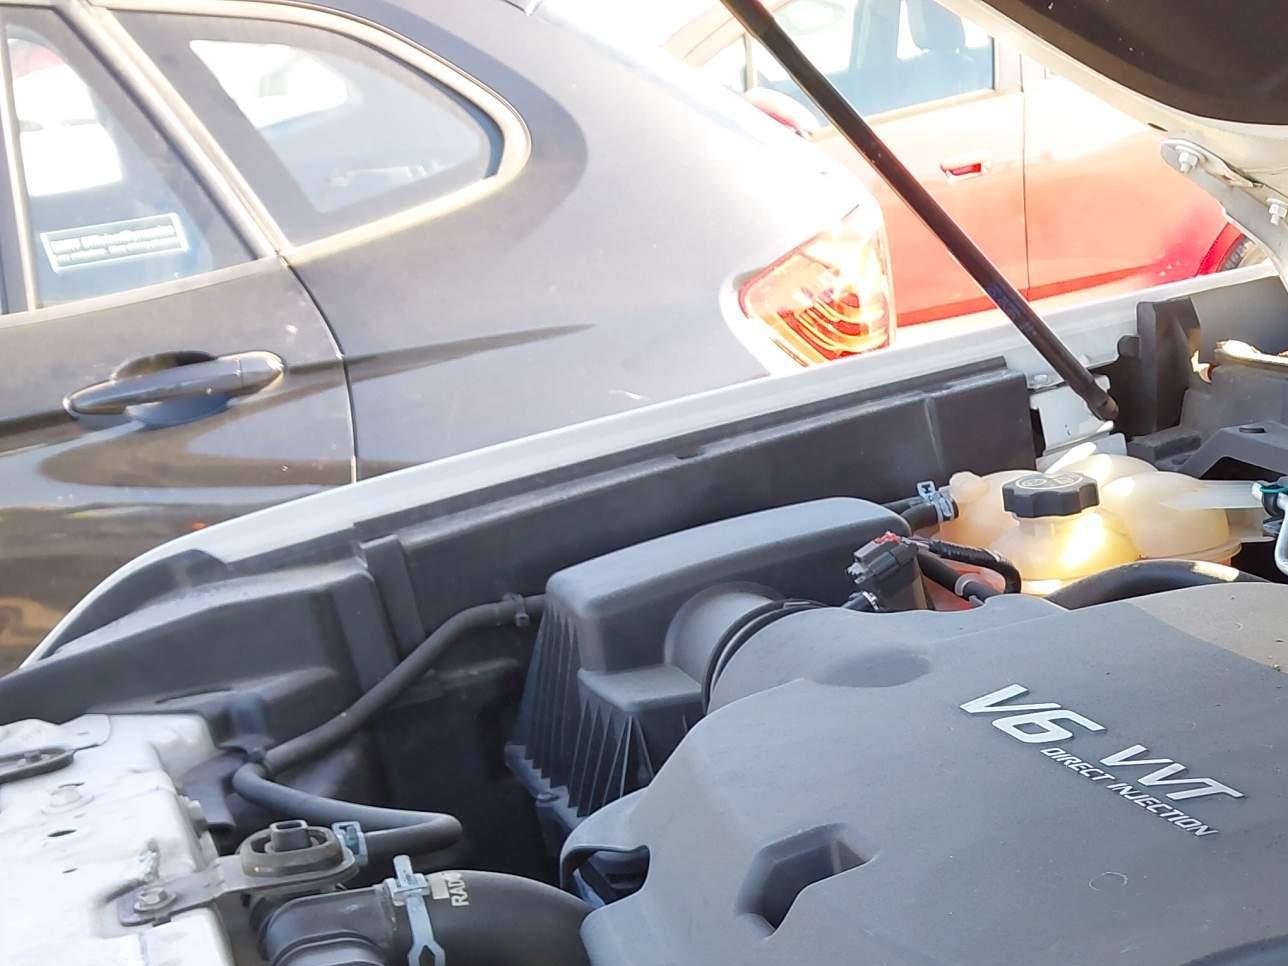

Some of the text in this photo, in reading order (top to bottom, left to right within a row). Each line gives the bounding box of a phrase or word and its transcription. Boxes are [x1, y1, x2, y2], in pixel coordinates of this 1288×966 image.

[959, 684, 1245, 801] V6 VVT
[1040, 747, 1219, 837] DIRECT INJECTION
